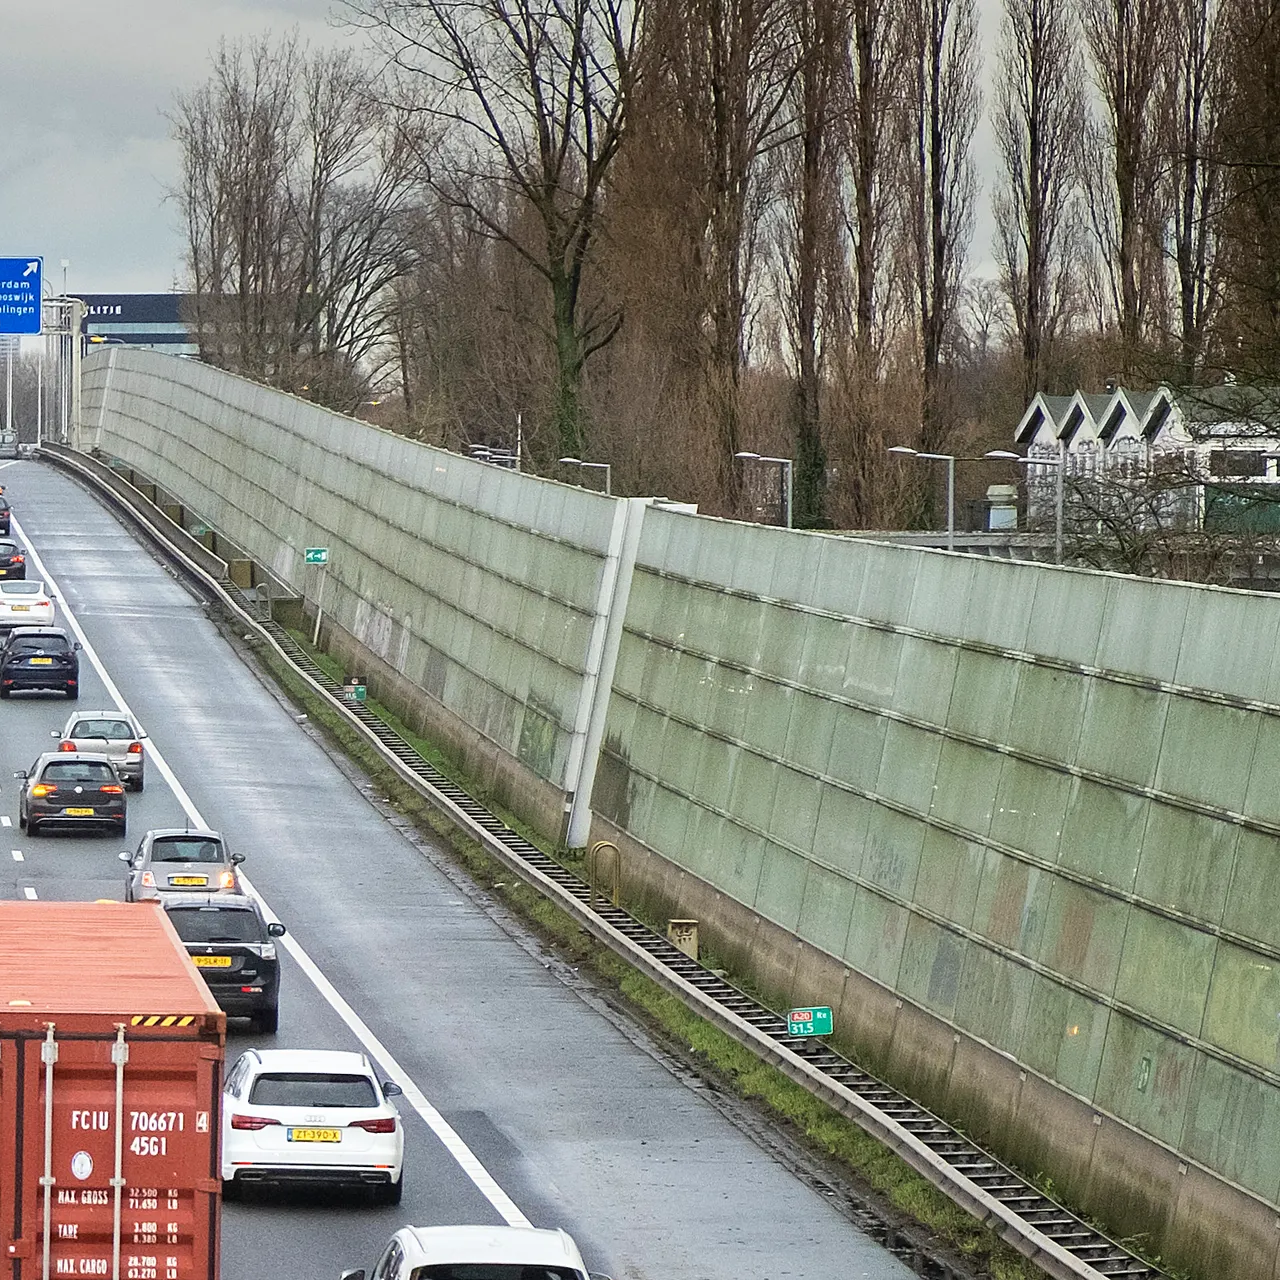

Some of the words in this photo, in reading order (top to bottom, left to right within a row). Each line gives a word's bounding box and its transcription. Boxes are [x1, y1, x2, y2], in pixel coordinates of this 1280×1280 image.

[793, 1012, 810, 1021] A20
[791, 1023, 814, 1034] 31.5
[72, 1110, 109, 1130] FCIU
[130, 1111, 184, 1131] 706671
[197, 1112, 207, 1131] 4
[130, 1136, 167, 1156] 45G1
[58, 1190, 79, 1204] MAX.
[81, 1190, 109, 1205] GROSS
[168, 1188, 178, 1198] KG
[167, 1199, 178, 1209] LB
[58, 1224, 79, 1239] TARE
[167, 1222, 178, 1233] KG
[167, 1234, 178, 1244] LB
[57, 1259, 78, 1274] MAX.
[80, 1259, 107, 1275] CARGO
[166, 1256, 177, 1267] KG
[166, 1268, 177, 1279] LB
